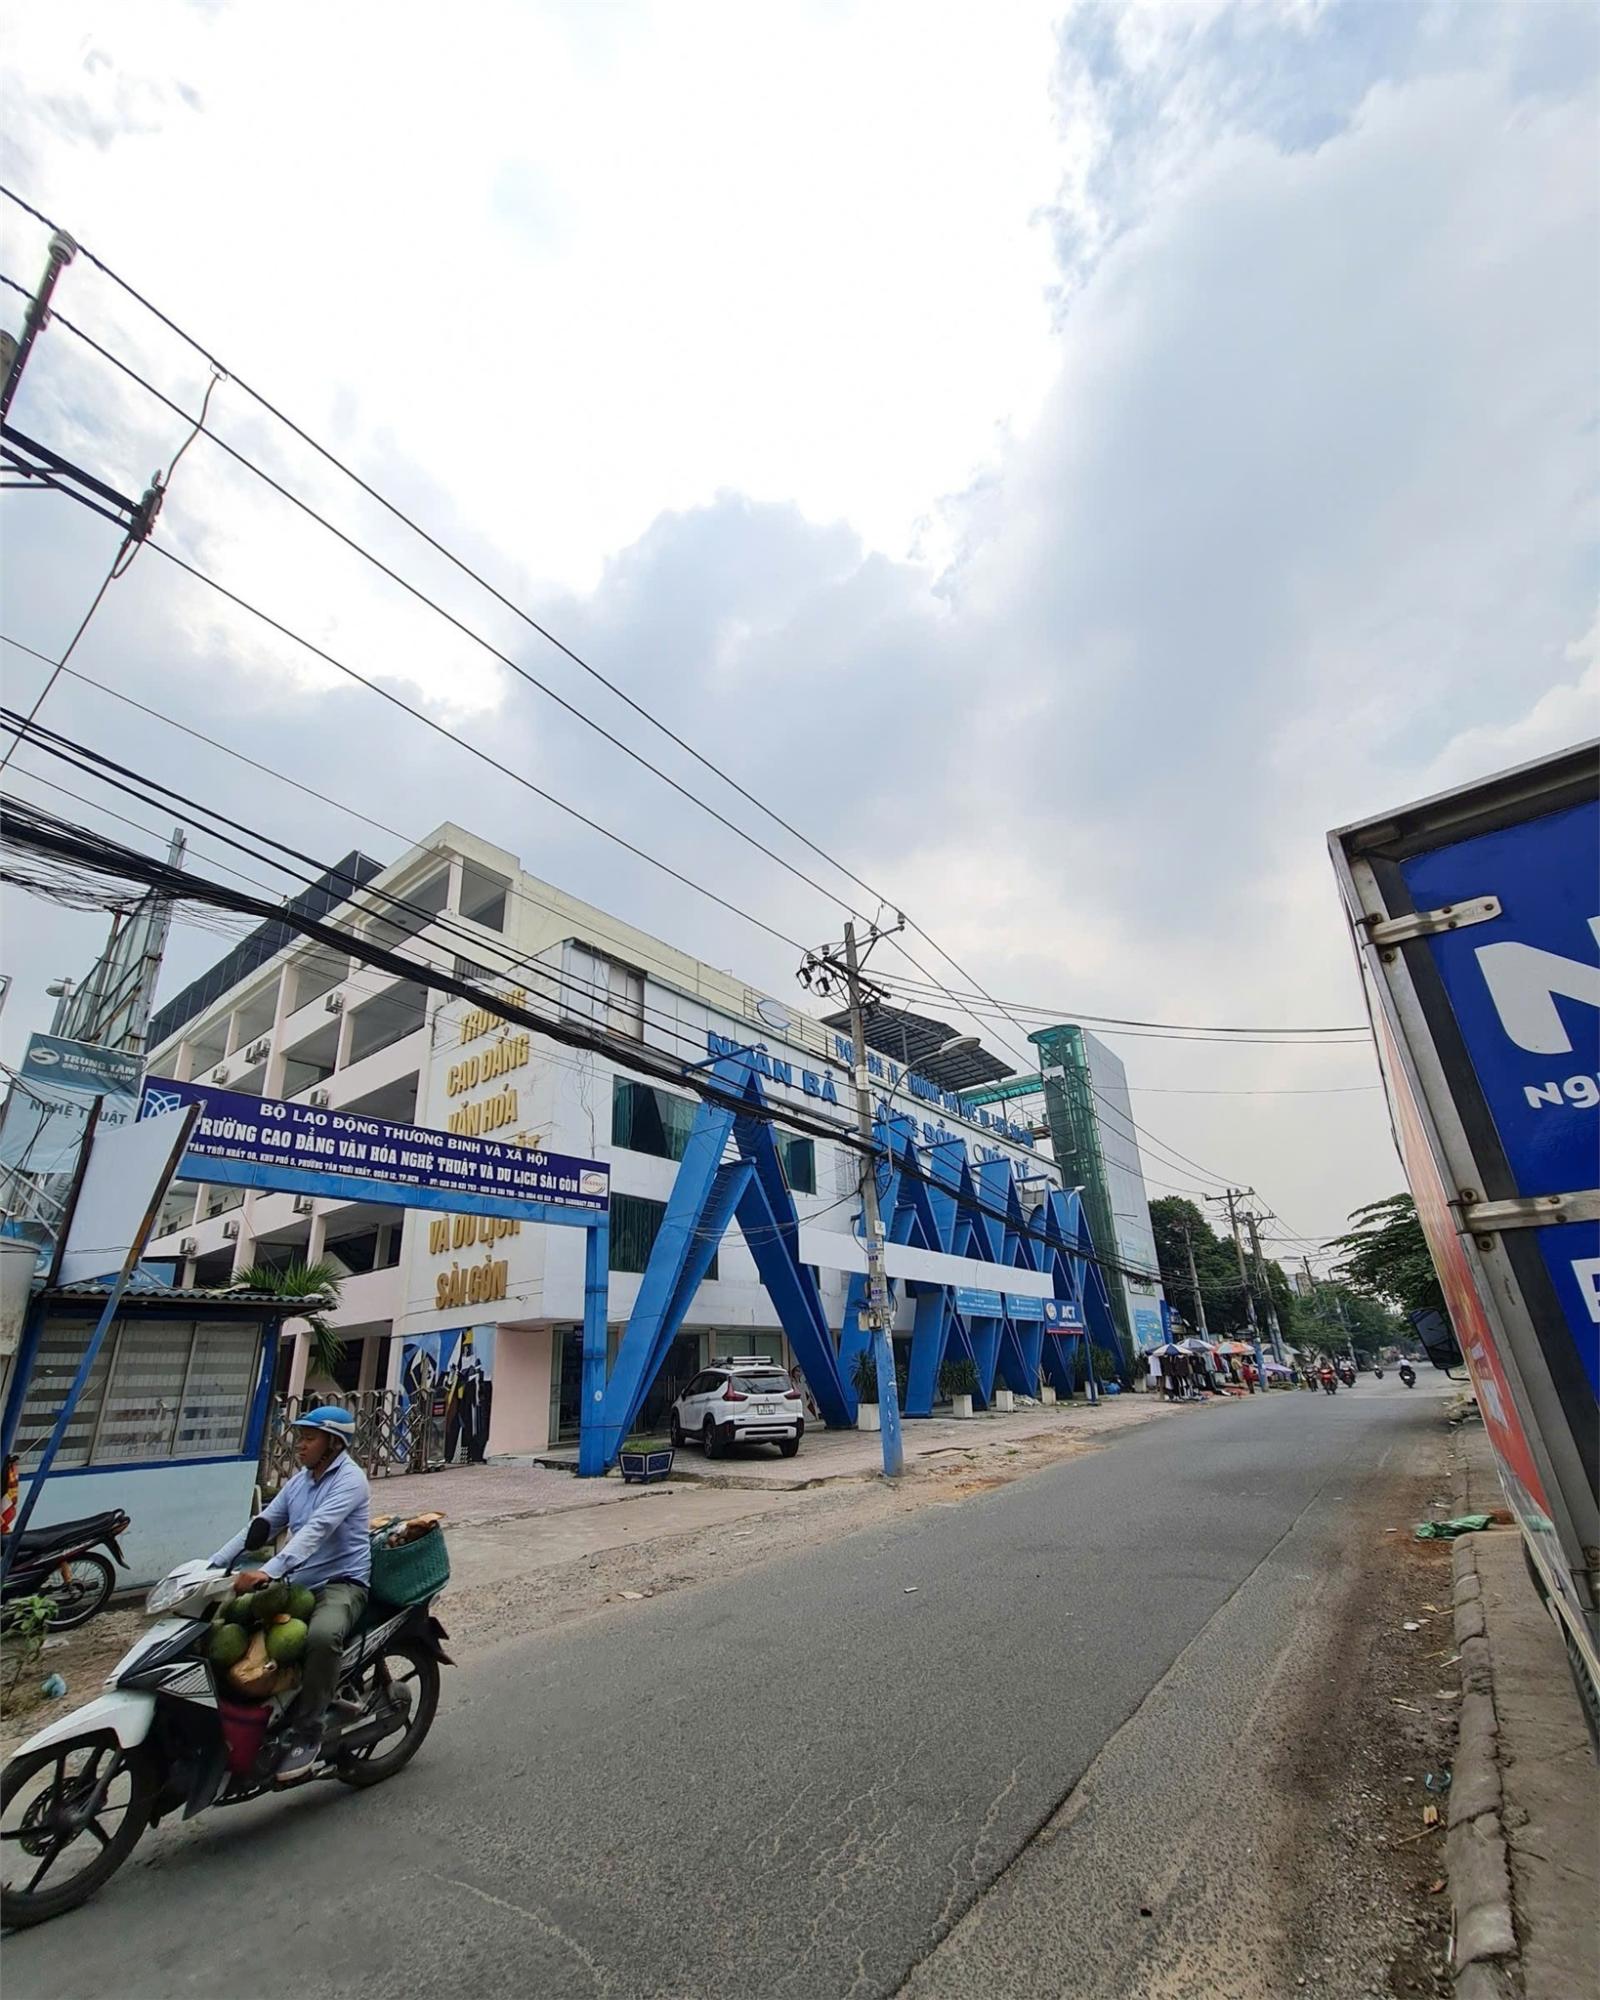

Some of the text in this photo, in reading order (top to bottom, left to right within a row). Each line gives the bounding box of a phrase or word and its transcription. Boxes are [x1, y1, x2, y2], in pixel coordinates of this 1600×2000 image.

[63, 1052, 107, 1070] TRUNG
[447, 1055, 479, 1098] CAO
[708, 1030, 792, 1088] NÂN
[29, 1100, 128, 1126] NGHỆ TUẬT
[260, 1103, 548, 1166] BỘ LAO ĐỘNG THƯƠNG BINH VÀ XÃ HỘI
[261, 1128, 291, 1149] CAO
[295, 1127, 335, 1155] ĐẲNG
[339, 1139, 366, 1159] VĂN
[371, 1144, 397, 1165] HÓA
[401, 1151, 434, 1173] NGHỆ
[437, 1157, 478, 1179] THUẬT
[480, 1162, 494, 1180] VÀ
[497, 1167, 511, 1182] DU
[514, 1170, 538, 1189] LỊCH
[540, 1171, 557, 1190] SÀI
[559, 1176, 578, 1194] GÒN
[452, 1215, 477, 1249] DU
[436, 1255, 508, 1310] SÀI GÒN
